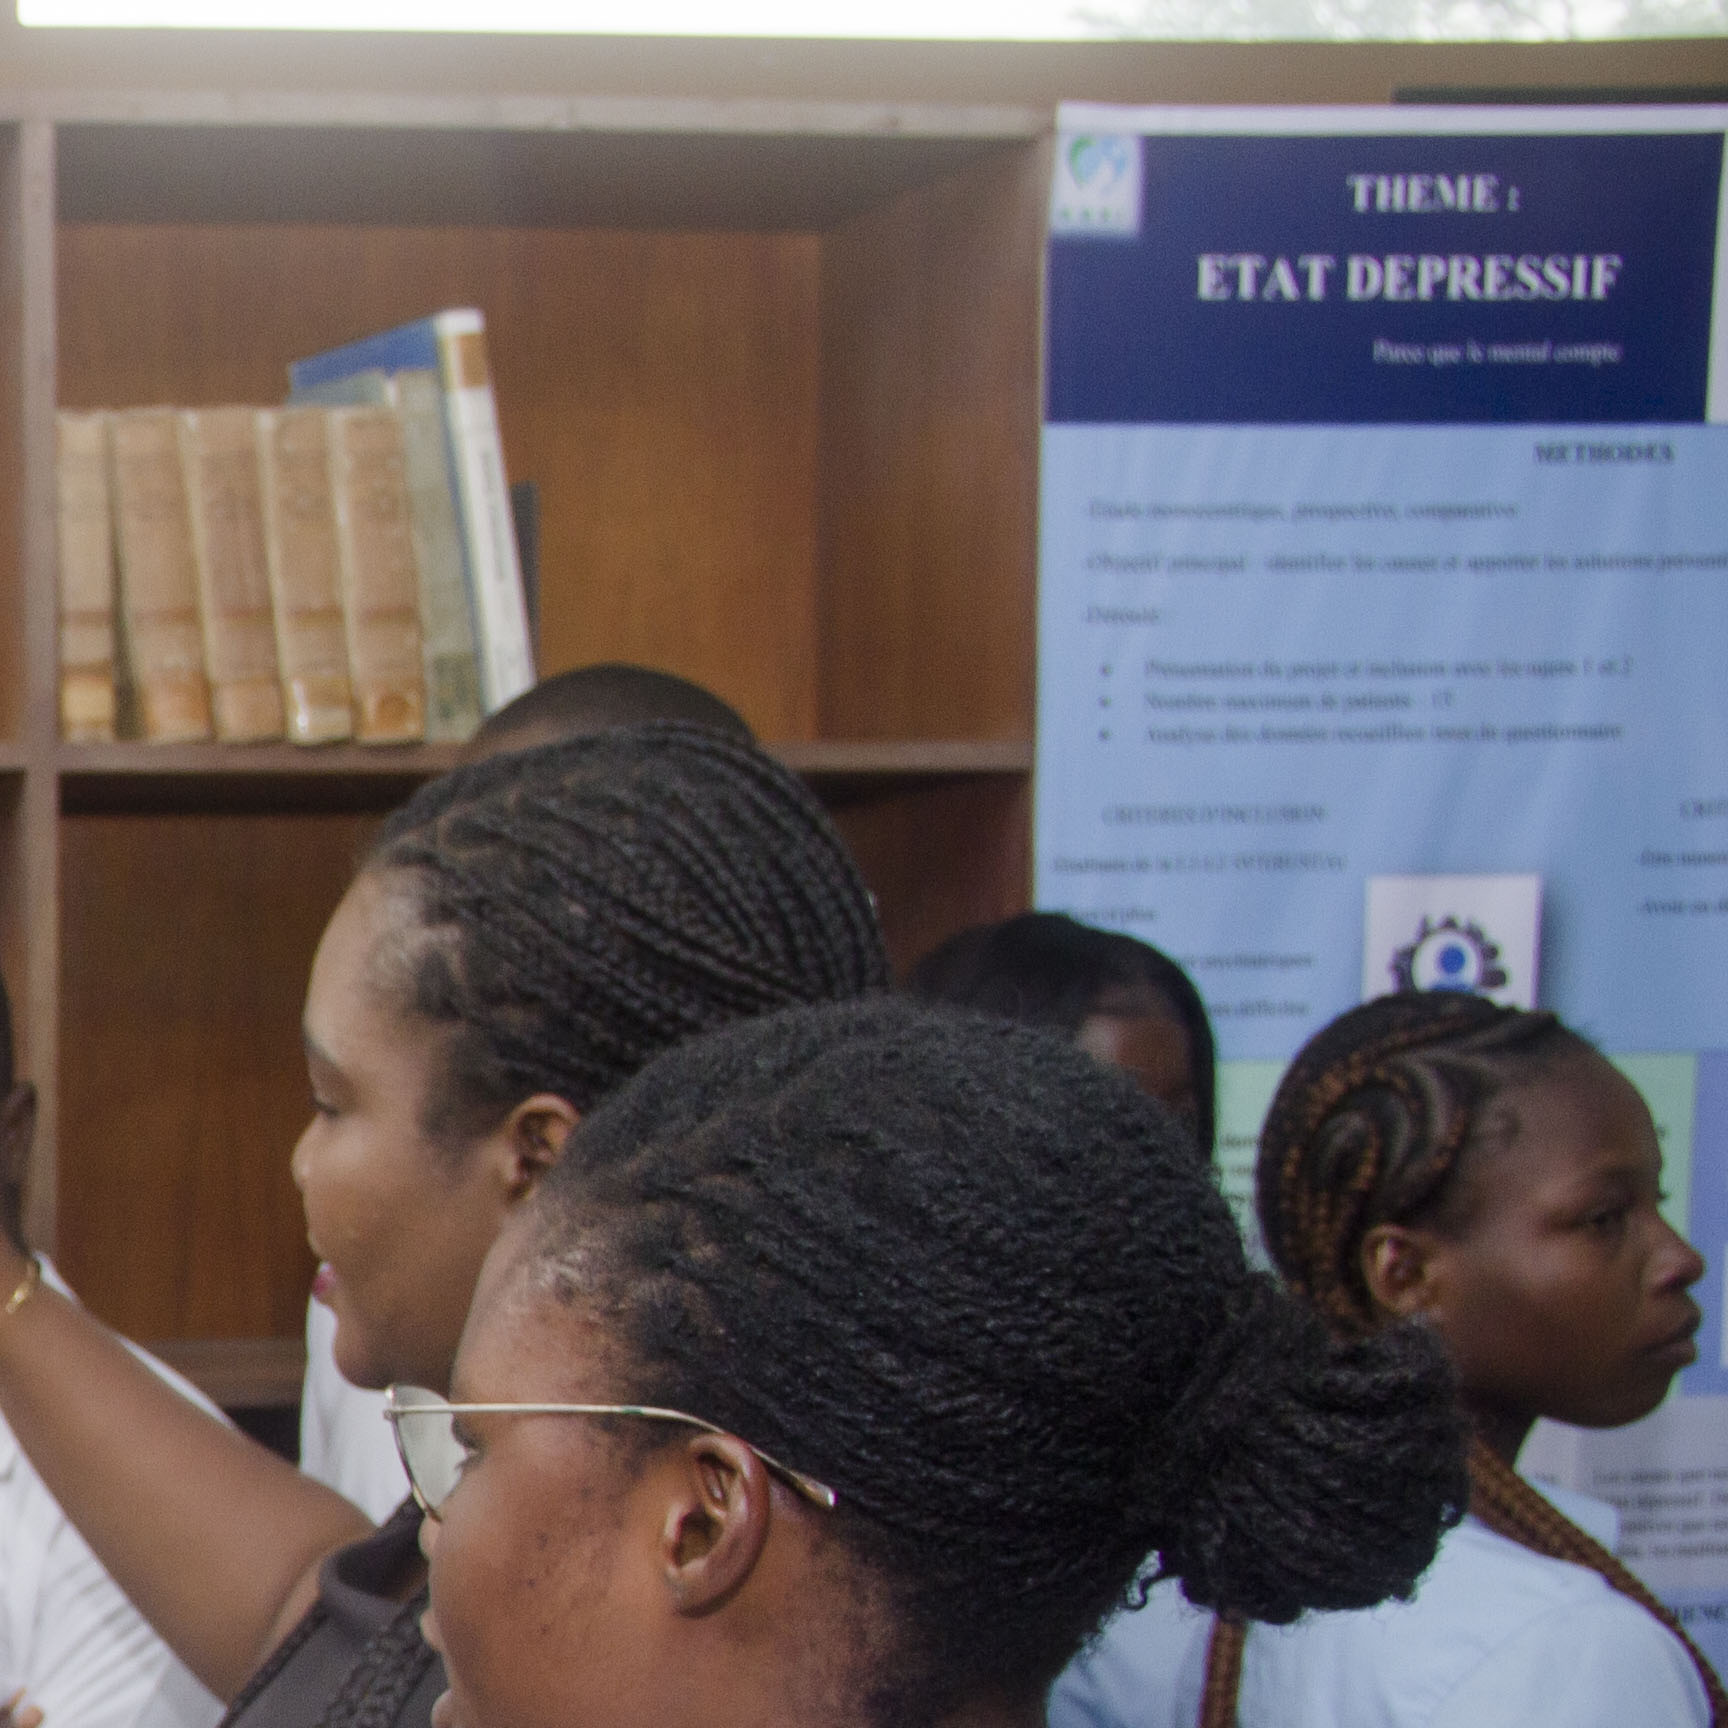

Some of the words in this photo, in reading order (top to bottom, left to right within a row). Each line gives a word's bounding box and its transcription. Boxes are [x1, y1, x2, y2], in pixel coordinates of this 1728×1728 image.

[1347, 174, 1499, 212] THEME
[1197, 254, 1336, 301] ETAT
[1347, 254, 1623, 302] DEPRESSIF
